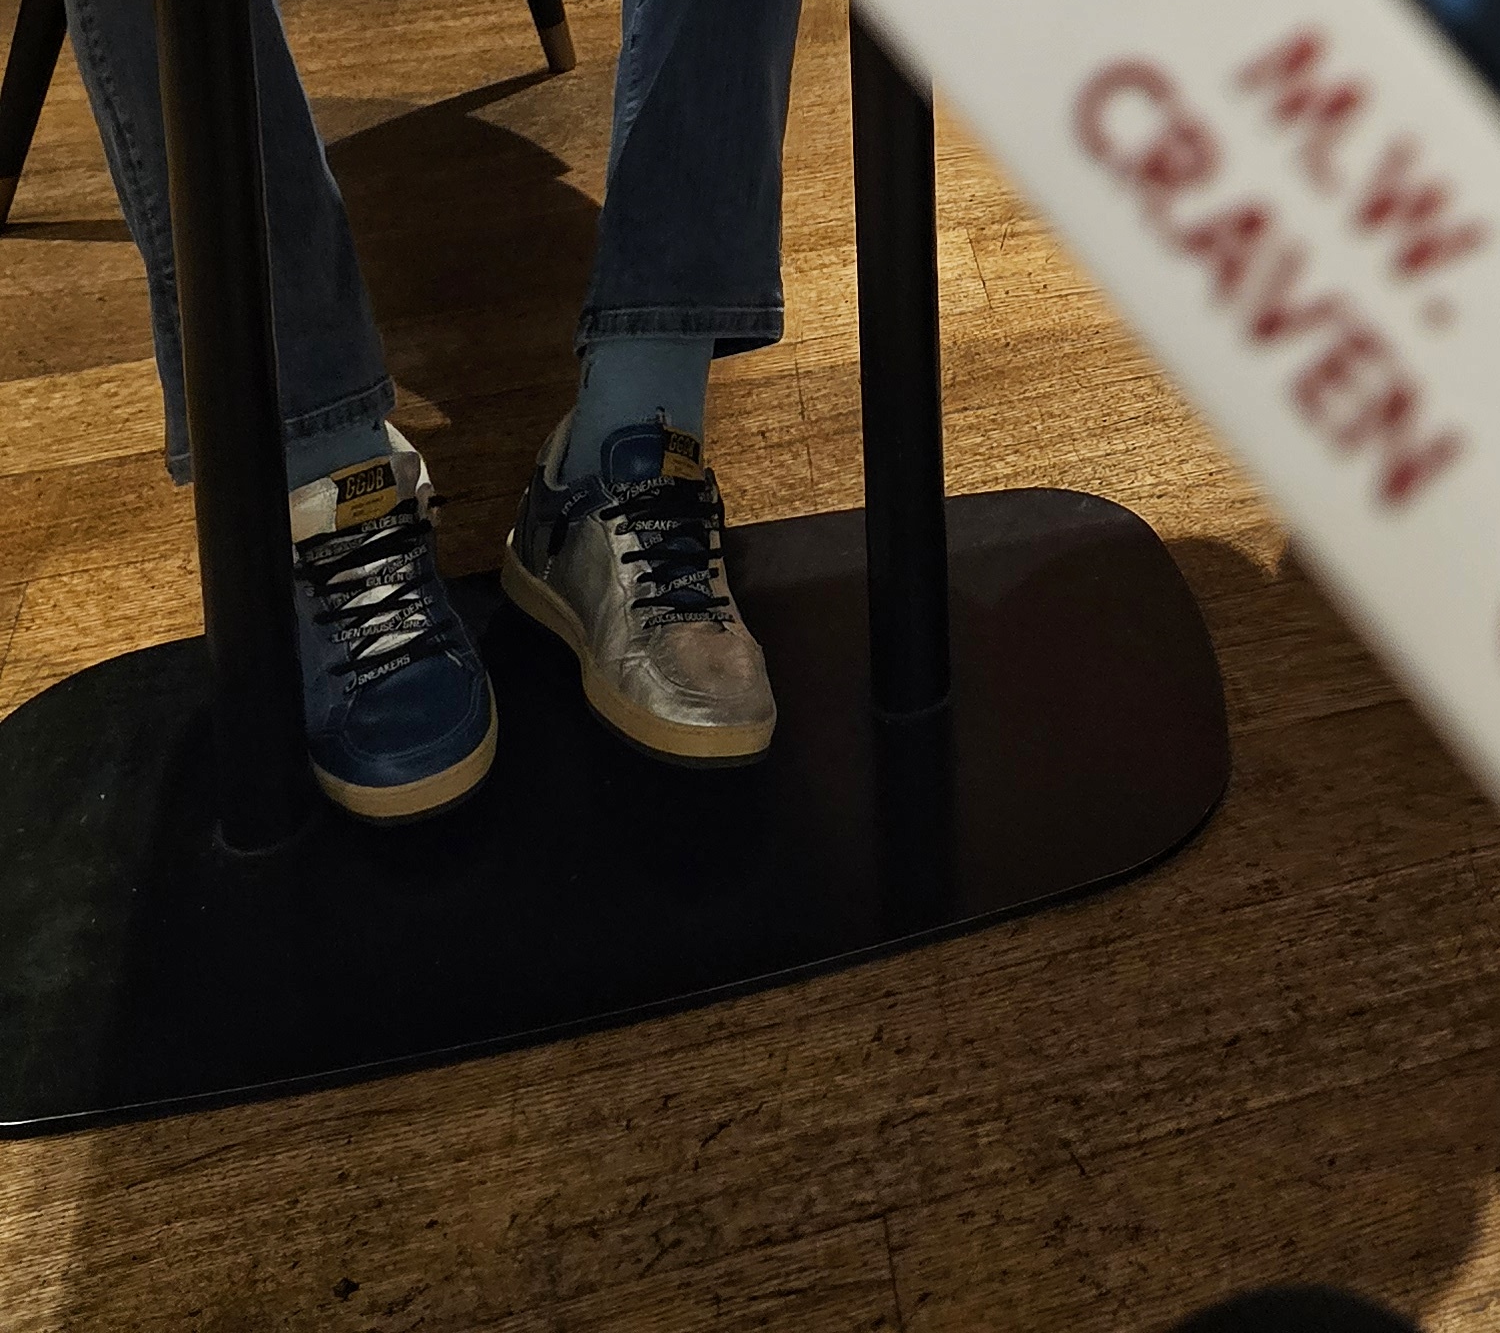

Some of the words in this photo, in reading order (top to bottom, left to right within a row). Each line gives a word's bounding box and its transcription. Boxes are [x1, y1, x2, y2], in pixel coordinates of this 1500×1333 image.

[1072, 55, 1470, 515] CRAVEN
[1235, 22, 1492, 331] M.W.
[345, 466, 385, 500] GGDB
